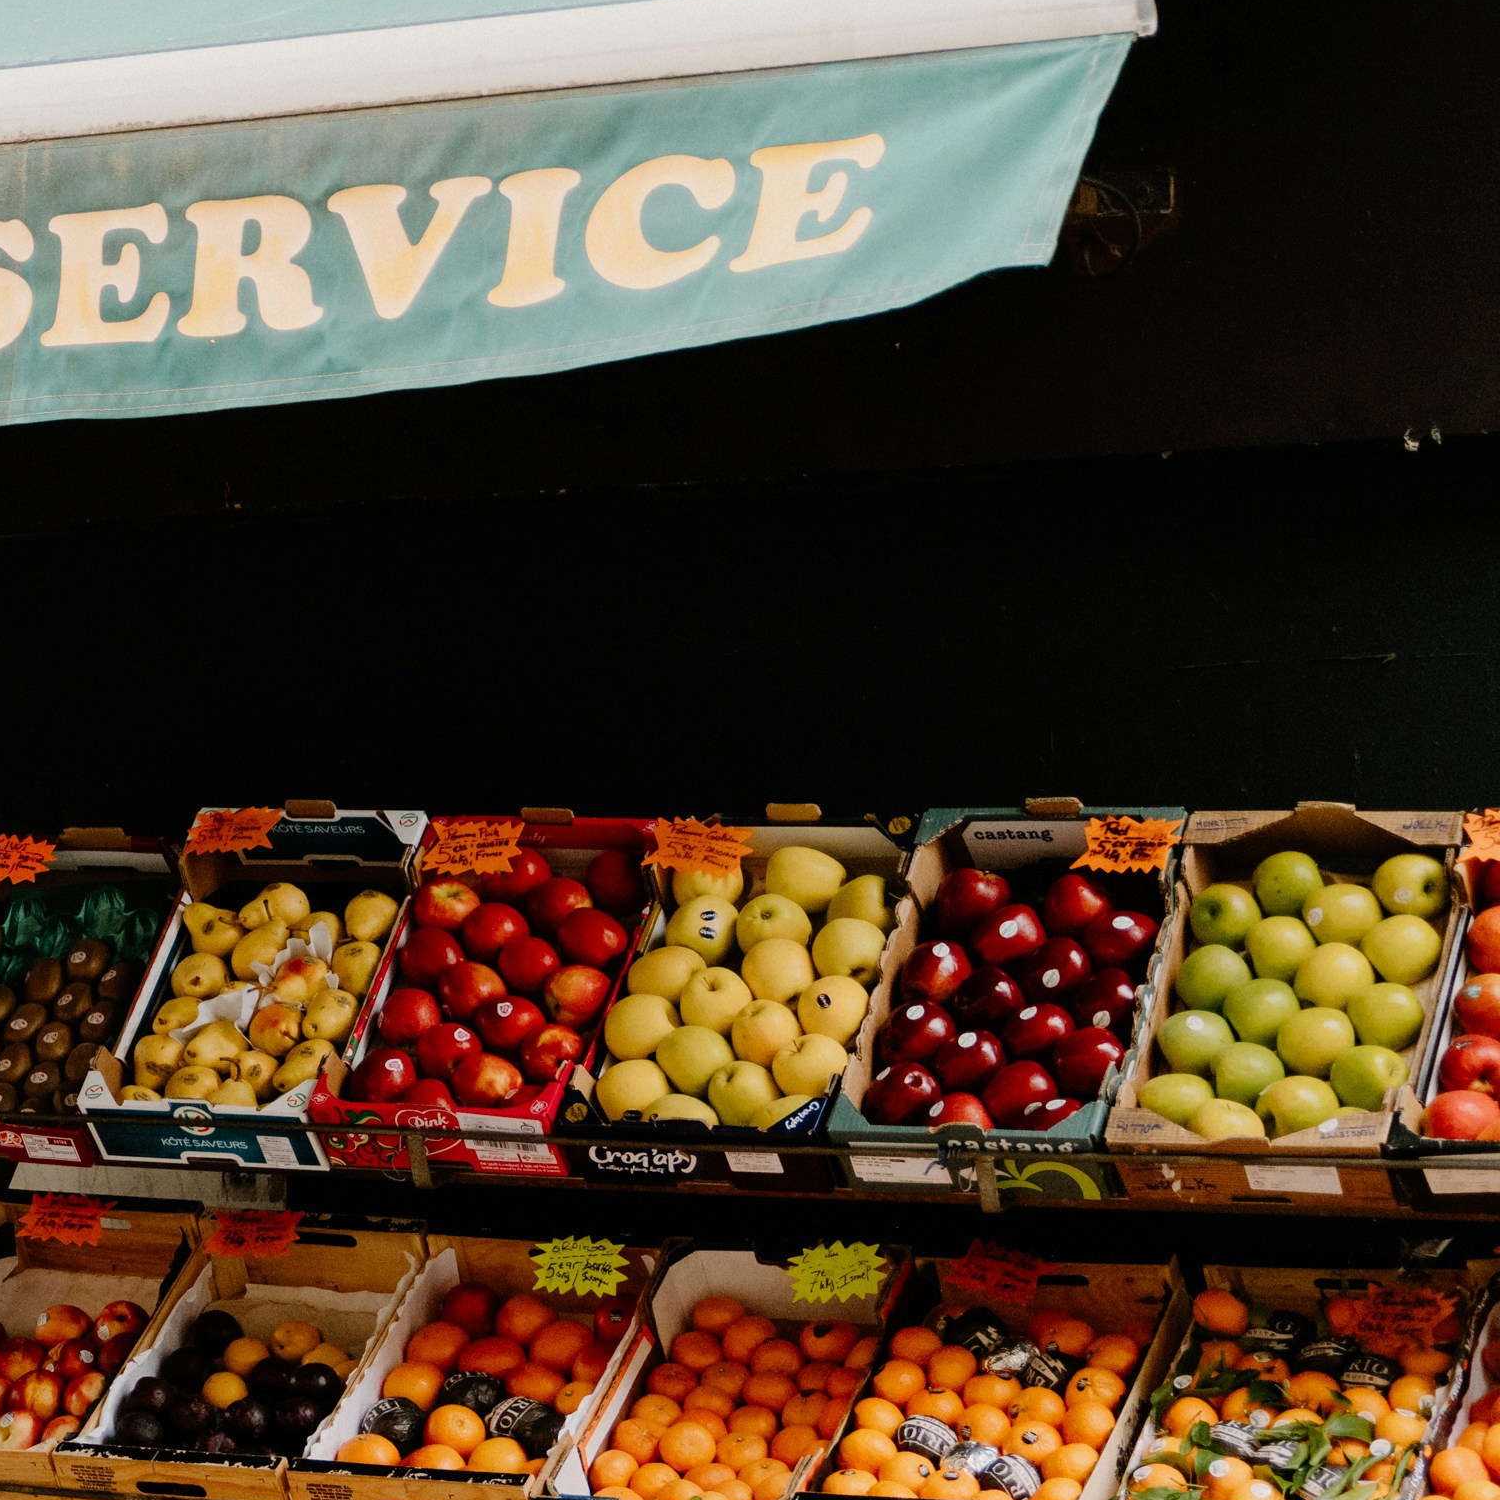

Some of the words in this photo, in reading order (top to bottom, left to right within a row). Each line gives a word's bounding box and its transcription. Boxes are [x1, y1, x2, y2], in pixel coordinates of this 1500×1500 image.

[305, 824, 366, 834] SAVEURS
[974, 828, 1053, 842] castang
[161, 1135, 192, 1148] KÔTÉ
[193, 1138, 248, 1150] SAVEURS
[588, 1145, 698, 1174] Croq'apy
[1348, 1357, 1390, 1375] RIO
[499, 1396, 532, 1430] RIO
